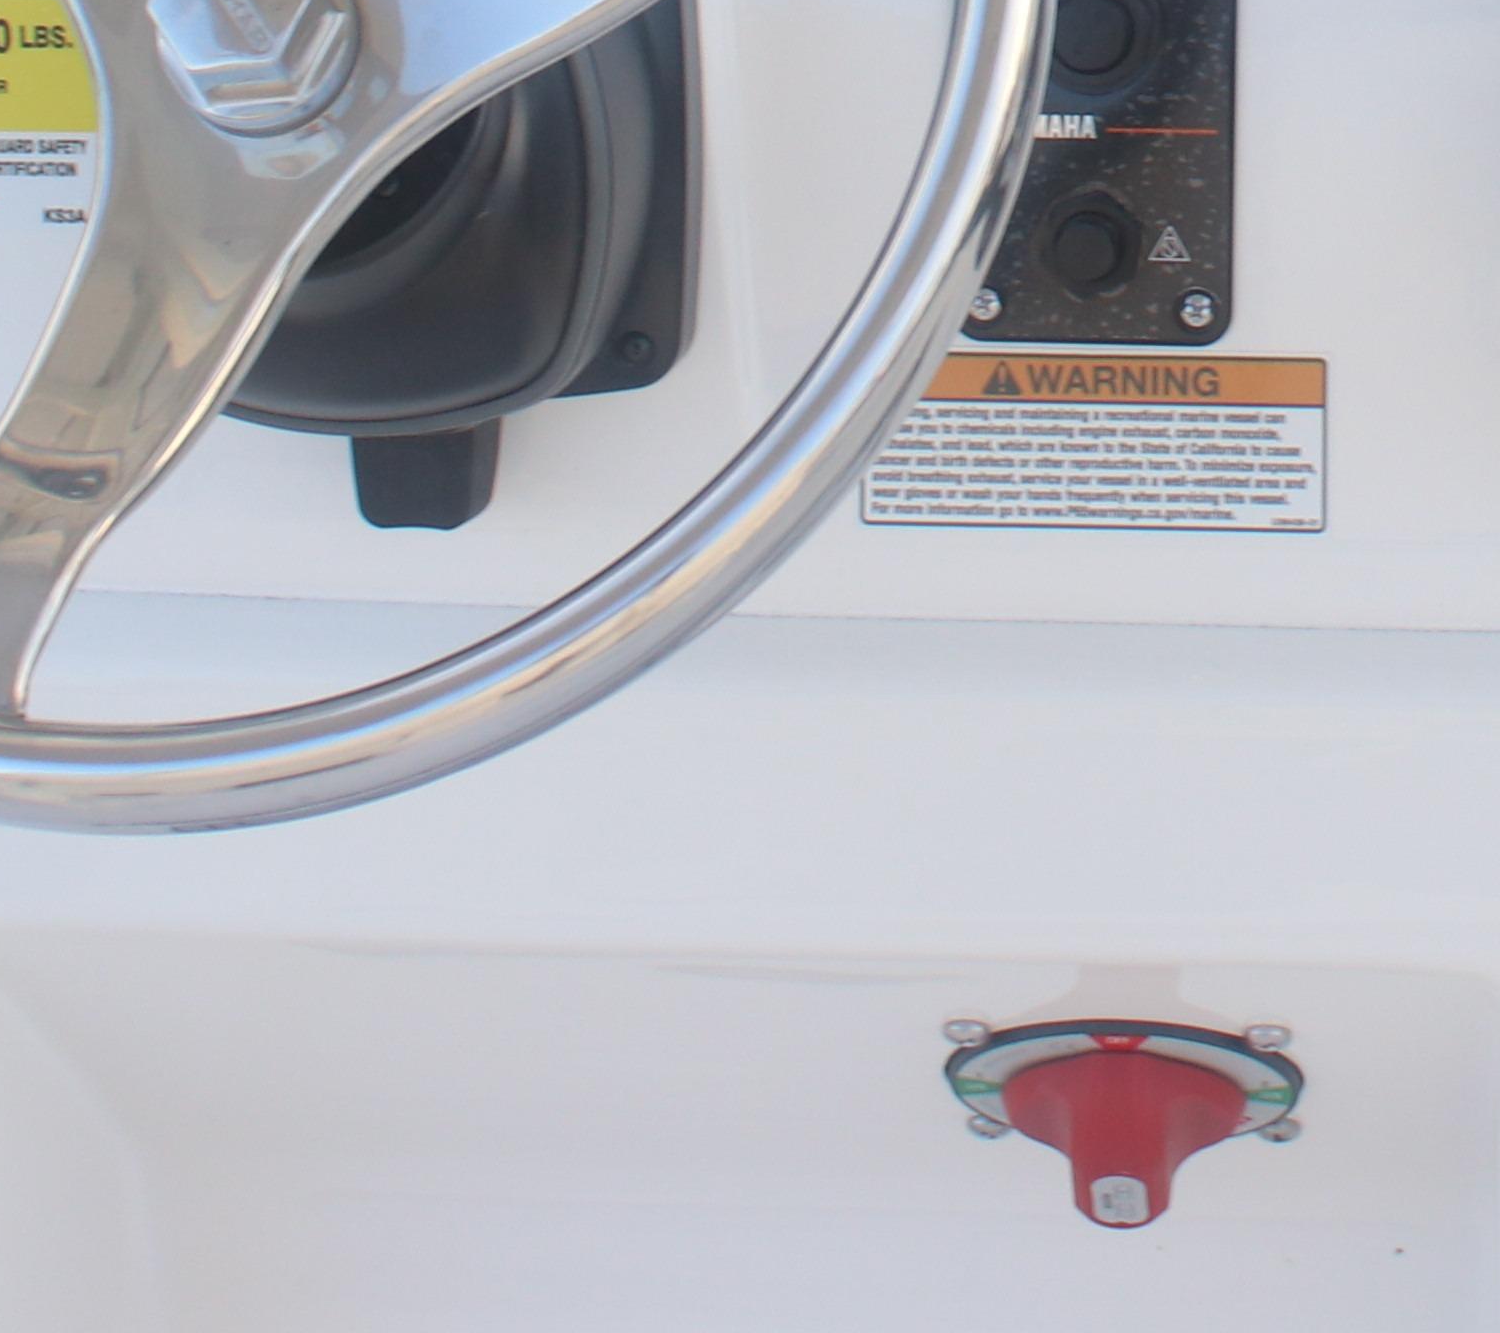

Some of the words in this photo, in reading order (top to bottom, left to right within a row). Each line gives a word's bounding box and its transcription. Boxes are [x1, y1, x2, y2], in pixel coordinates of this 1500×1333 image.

[19, 25, 73, 48] LBS.
[38, 139, 87, 154] SAFETY
[1027, 366, 1220, 397] WARNING
